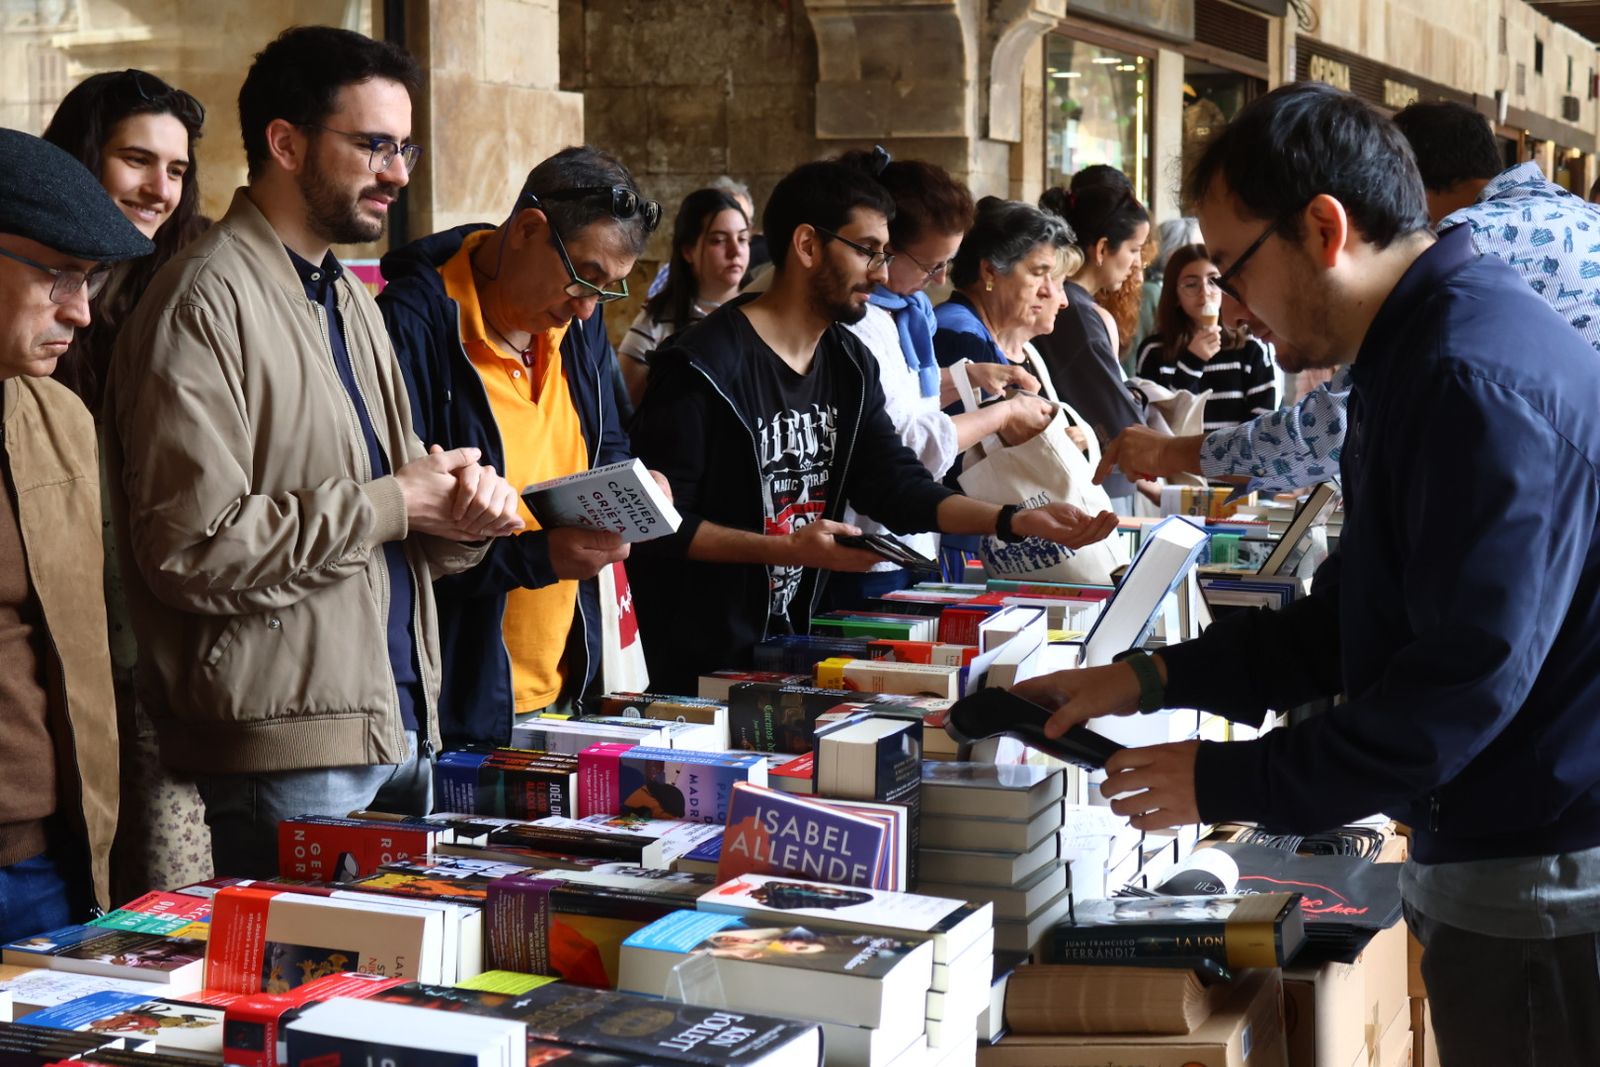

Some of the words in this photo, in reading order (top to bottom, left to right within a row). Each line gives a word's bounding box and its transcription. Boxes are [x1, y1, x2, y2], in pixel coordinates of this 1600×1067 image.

[592, 491, 626, 533] GRIETA
[608, 481, 649, 534] CASTILLO
[624, 486, 656, 525] JAVIER
[549, 782, 563, 803] JOËL
[294, 830, 306, 873] NOR
[753, 806, 852, 857] ISABEL
[729, 832, 868, 886] ALLENDE
[1089, 938, 1136, 947] FRANCISCO
[1175, 937, 1192, 947] LA
[1197, 936, 1225, 946] LON
[658, 1011, 746, 1053] FOLLETT
[708, 1025, 757, 1048] KEN
